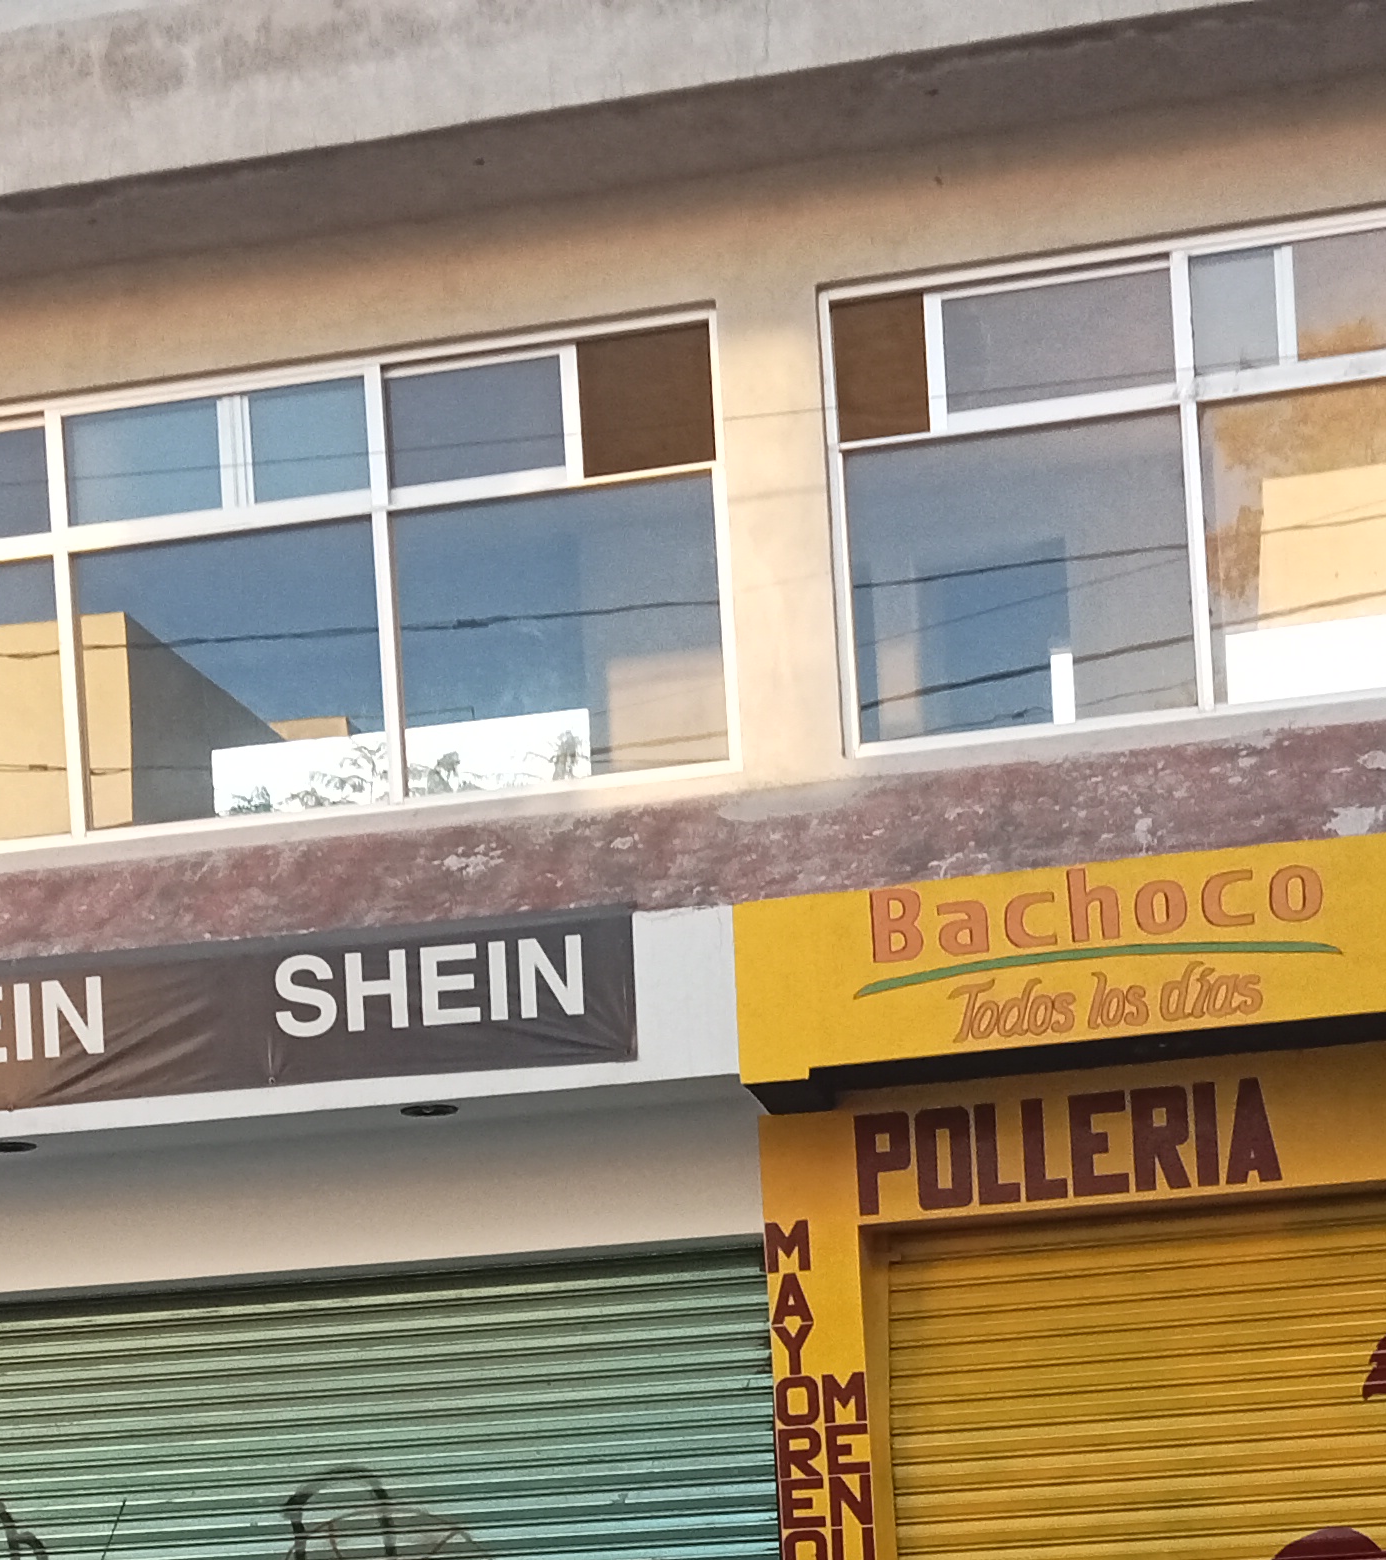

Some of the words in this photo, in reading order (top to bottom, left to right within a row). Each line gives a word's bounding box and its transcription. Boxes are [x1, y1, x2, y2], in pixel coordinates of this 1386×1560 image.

[869, 865, 1323, 963] Bachoco
[274, 934, 584, 1038] SHEIN
[949, 977, 1076, 1043] Todos
[1088, 972, 1149, 1030] los
[1160, 961, 1264, 1022] días
[853, 1077, 1282, 1216] POLLERIA
